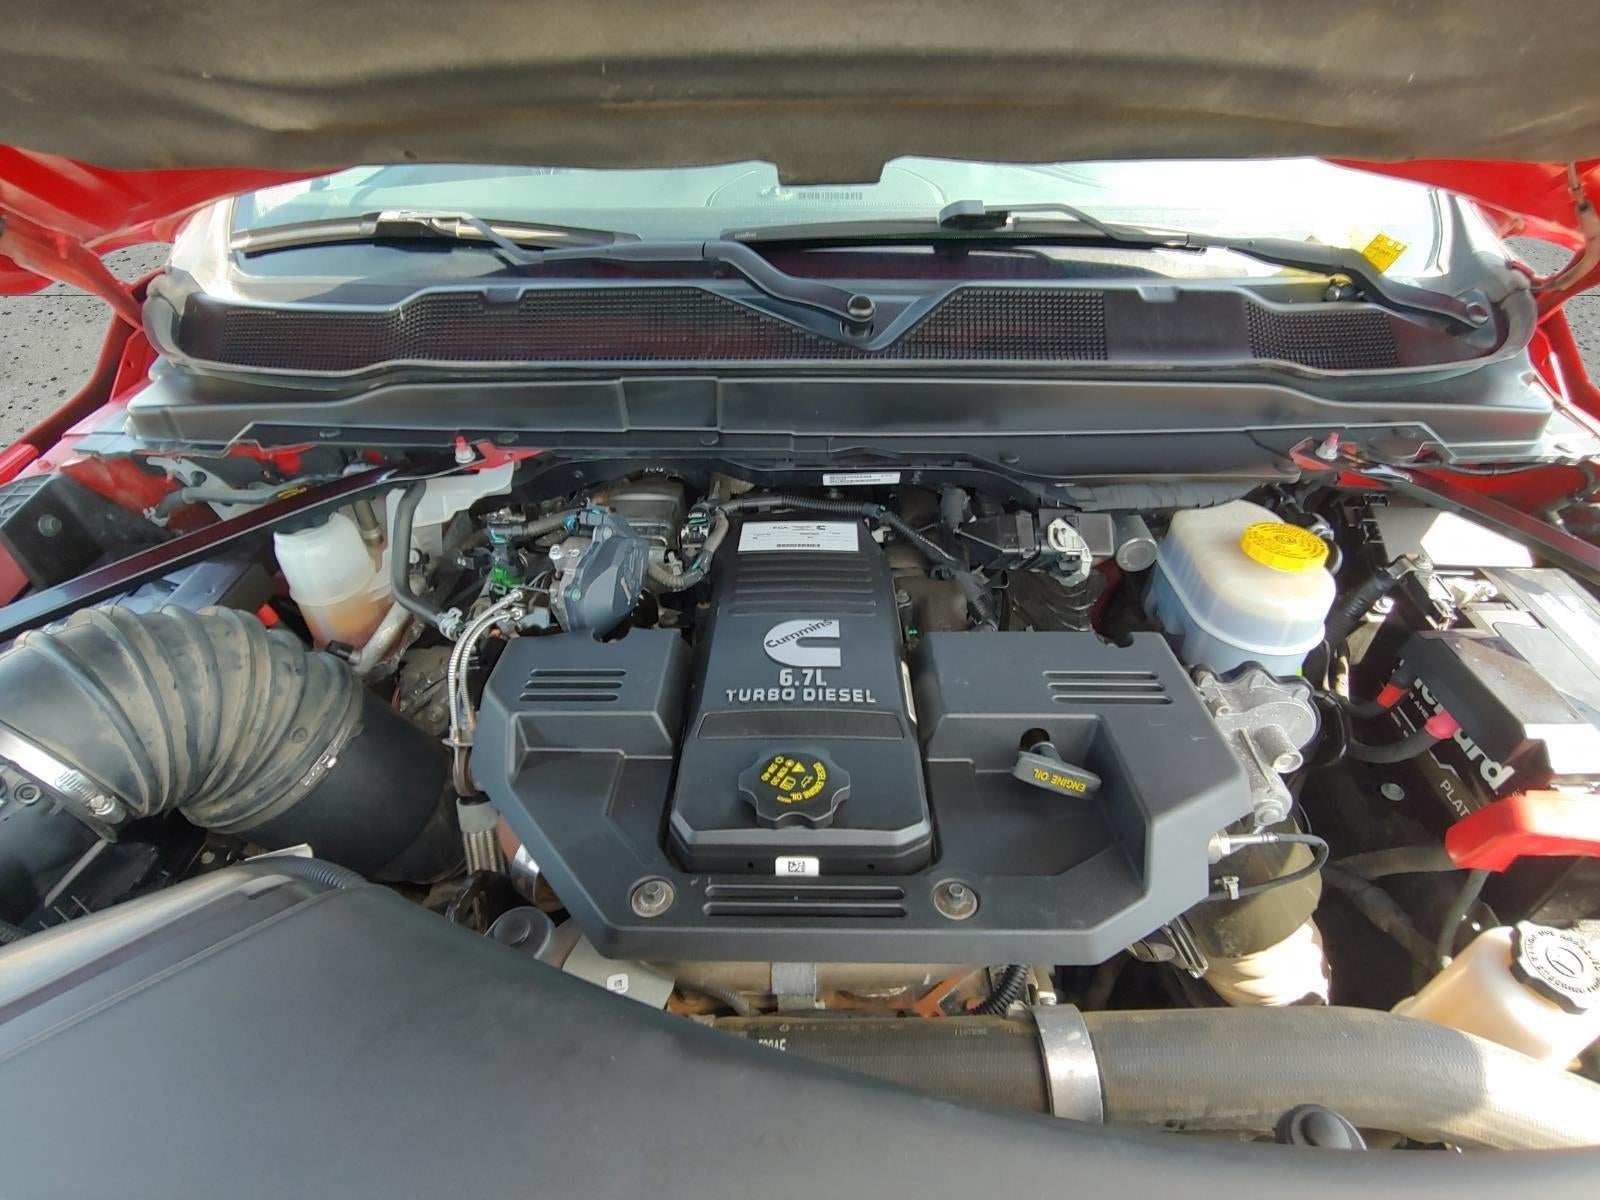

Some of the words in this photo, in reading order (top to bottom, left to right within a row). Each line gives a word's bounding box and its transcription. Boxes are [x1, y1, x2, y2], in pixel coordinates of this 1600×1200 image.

[765, 619, 833, 648] Cummins
[779, 668, 827, 687] 6.7L
[726, 687, 796, 703] TURBO
[802, 688, 877, 703] DIESEL
[1034, 769, 1049, 781] OIL
[1050, 774, 1086, 792] ENGINE
